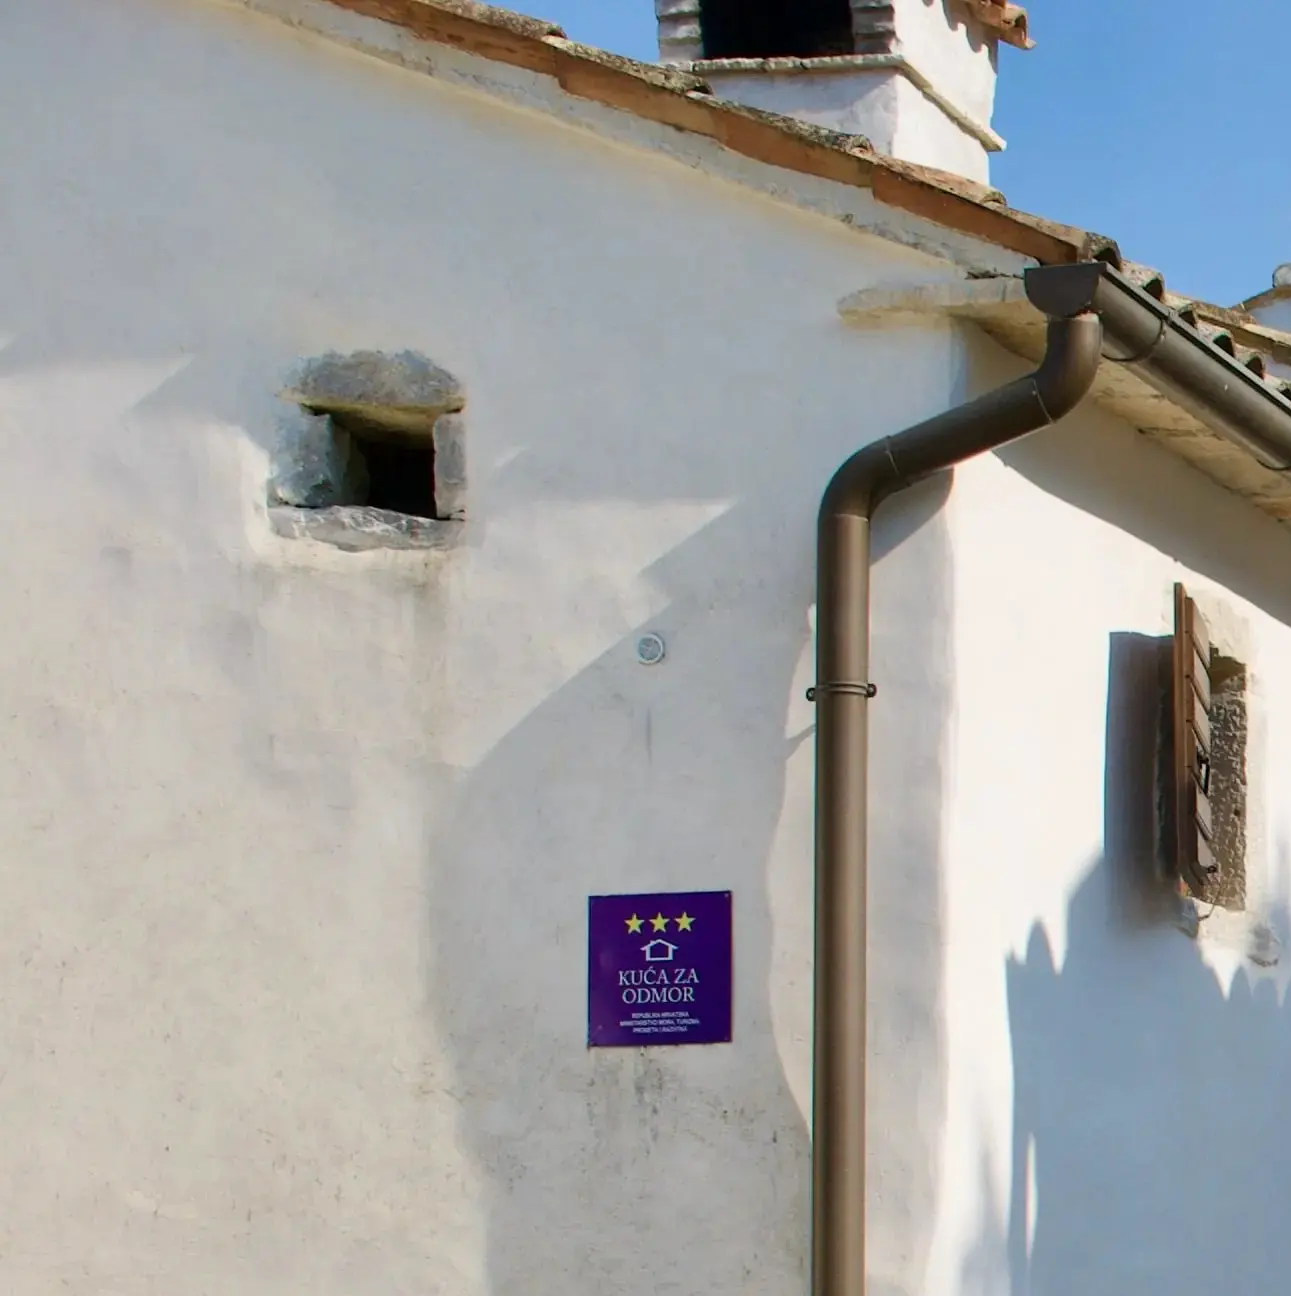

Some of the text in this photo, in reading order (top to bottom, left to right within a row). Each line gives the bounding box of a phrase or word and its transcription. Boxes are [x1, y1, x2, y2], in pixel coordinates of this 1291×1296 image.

[618, 966, 699, 986] KUĆA ZA
[622, 987, 695, 1004] ODMOR
